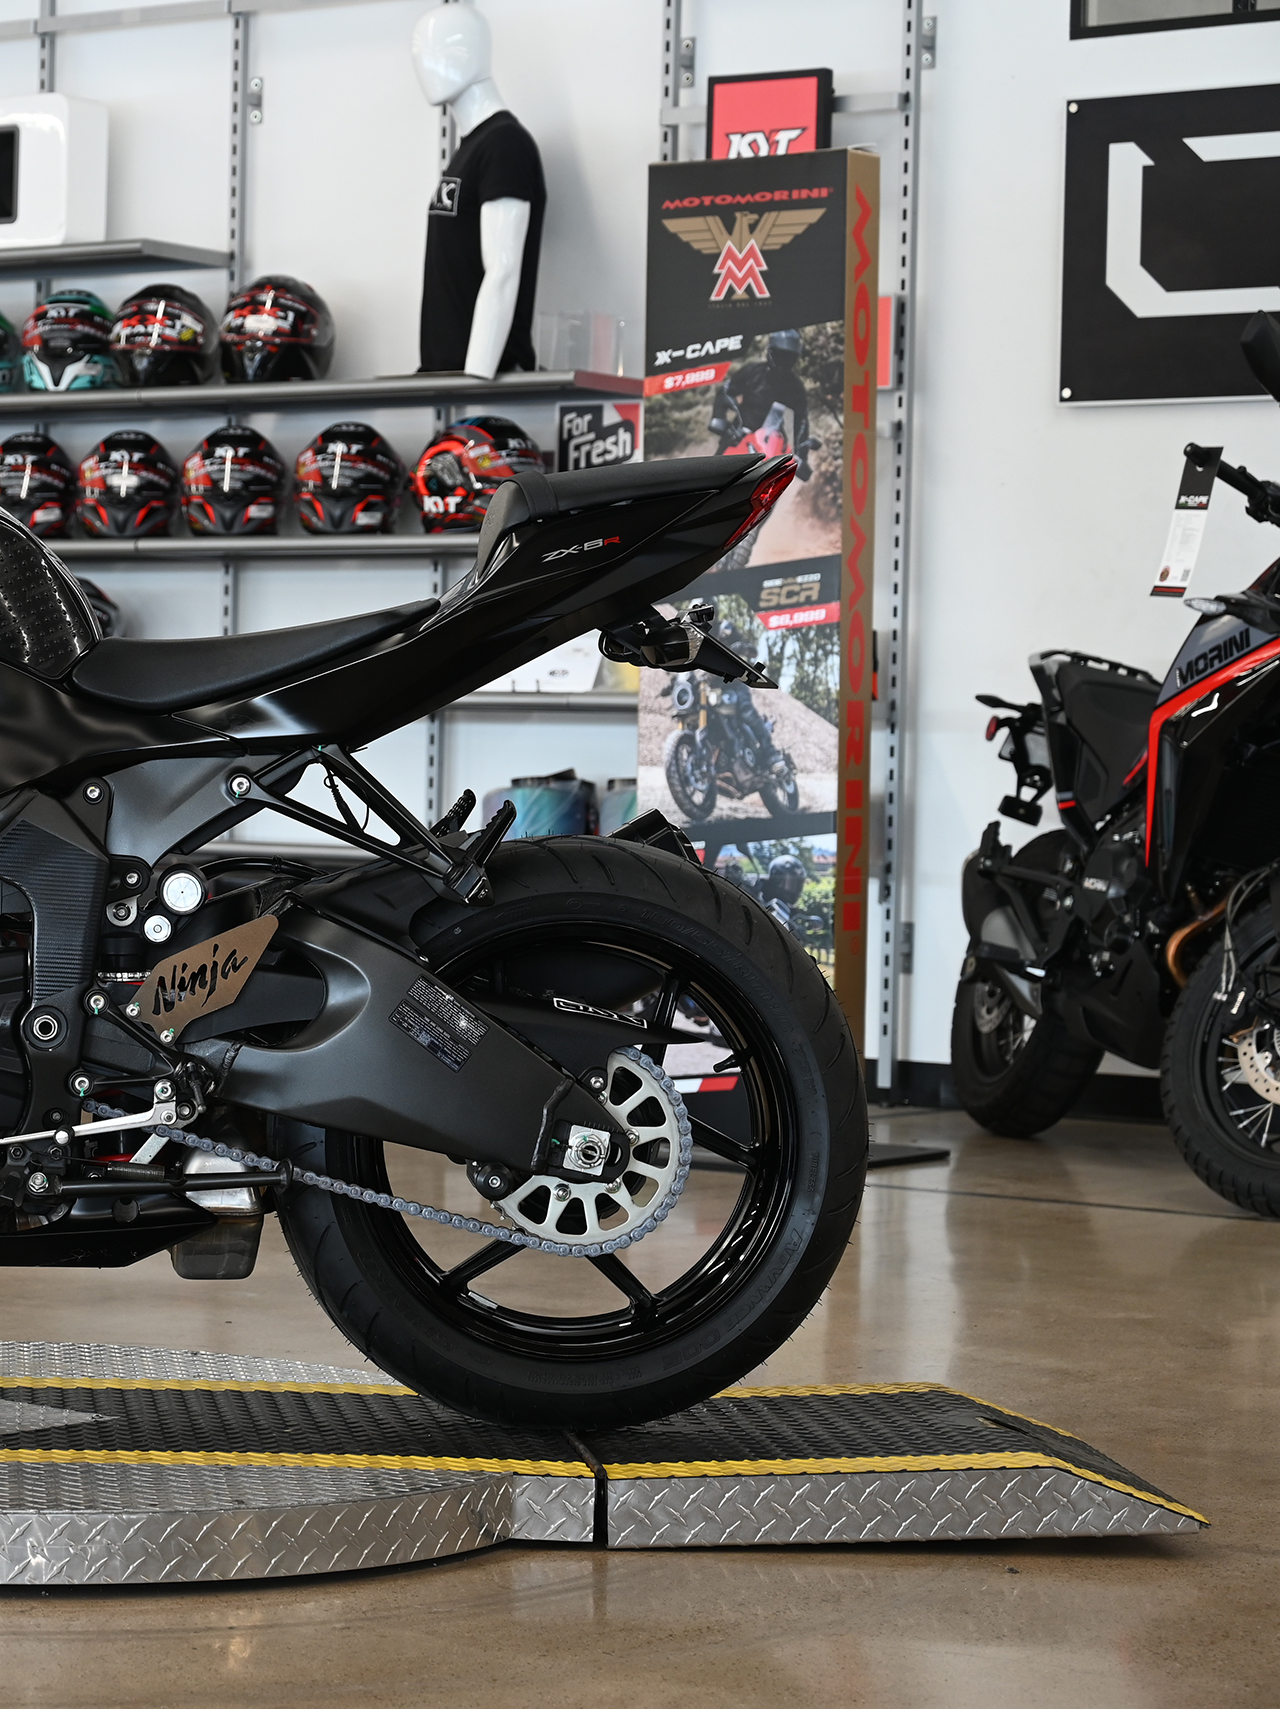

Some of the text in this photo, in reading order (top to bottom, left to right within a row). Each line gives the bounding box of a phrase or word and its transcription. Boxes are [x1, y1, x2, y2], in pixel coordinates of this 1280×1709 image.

[726, 126, 808, 160] KYT
[661, 186, 830, 209] MOTOMORINI
[654, 334, 744, 366] X-CAPE
[563, 412, 593, 440] For
[569, 426, 633, 470] Fresh
[422, 495, 463, 514] KYT
[541, 536, 622, 563] ZX-6R
[1179, 627, 1251, 685] MORINI
[152, 943, 249, 1016] Ninja
